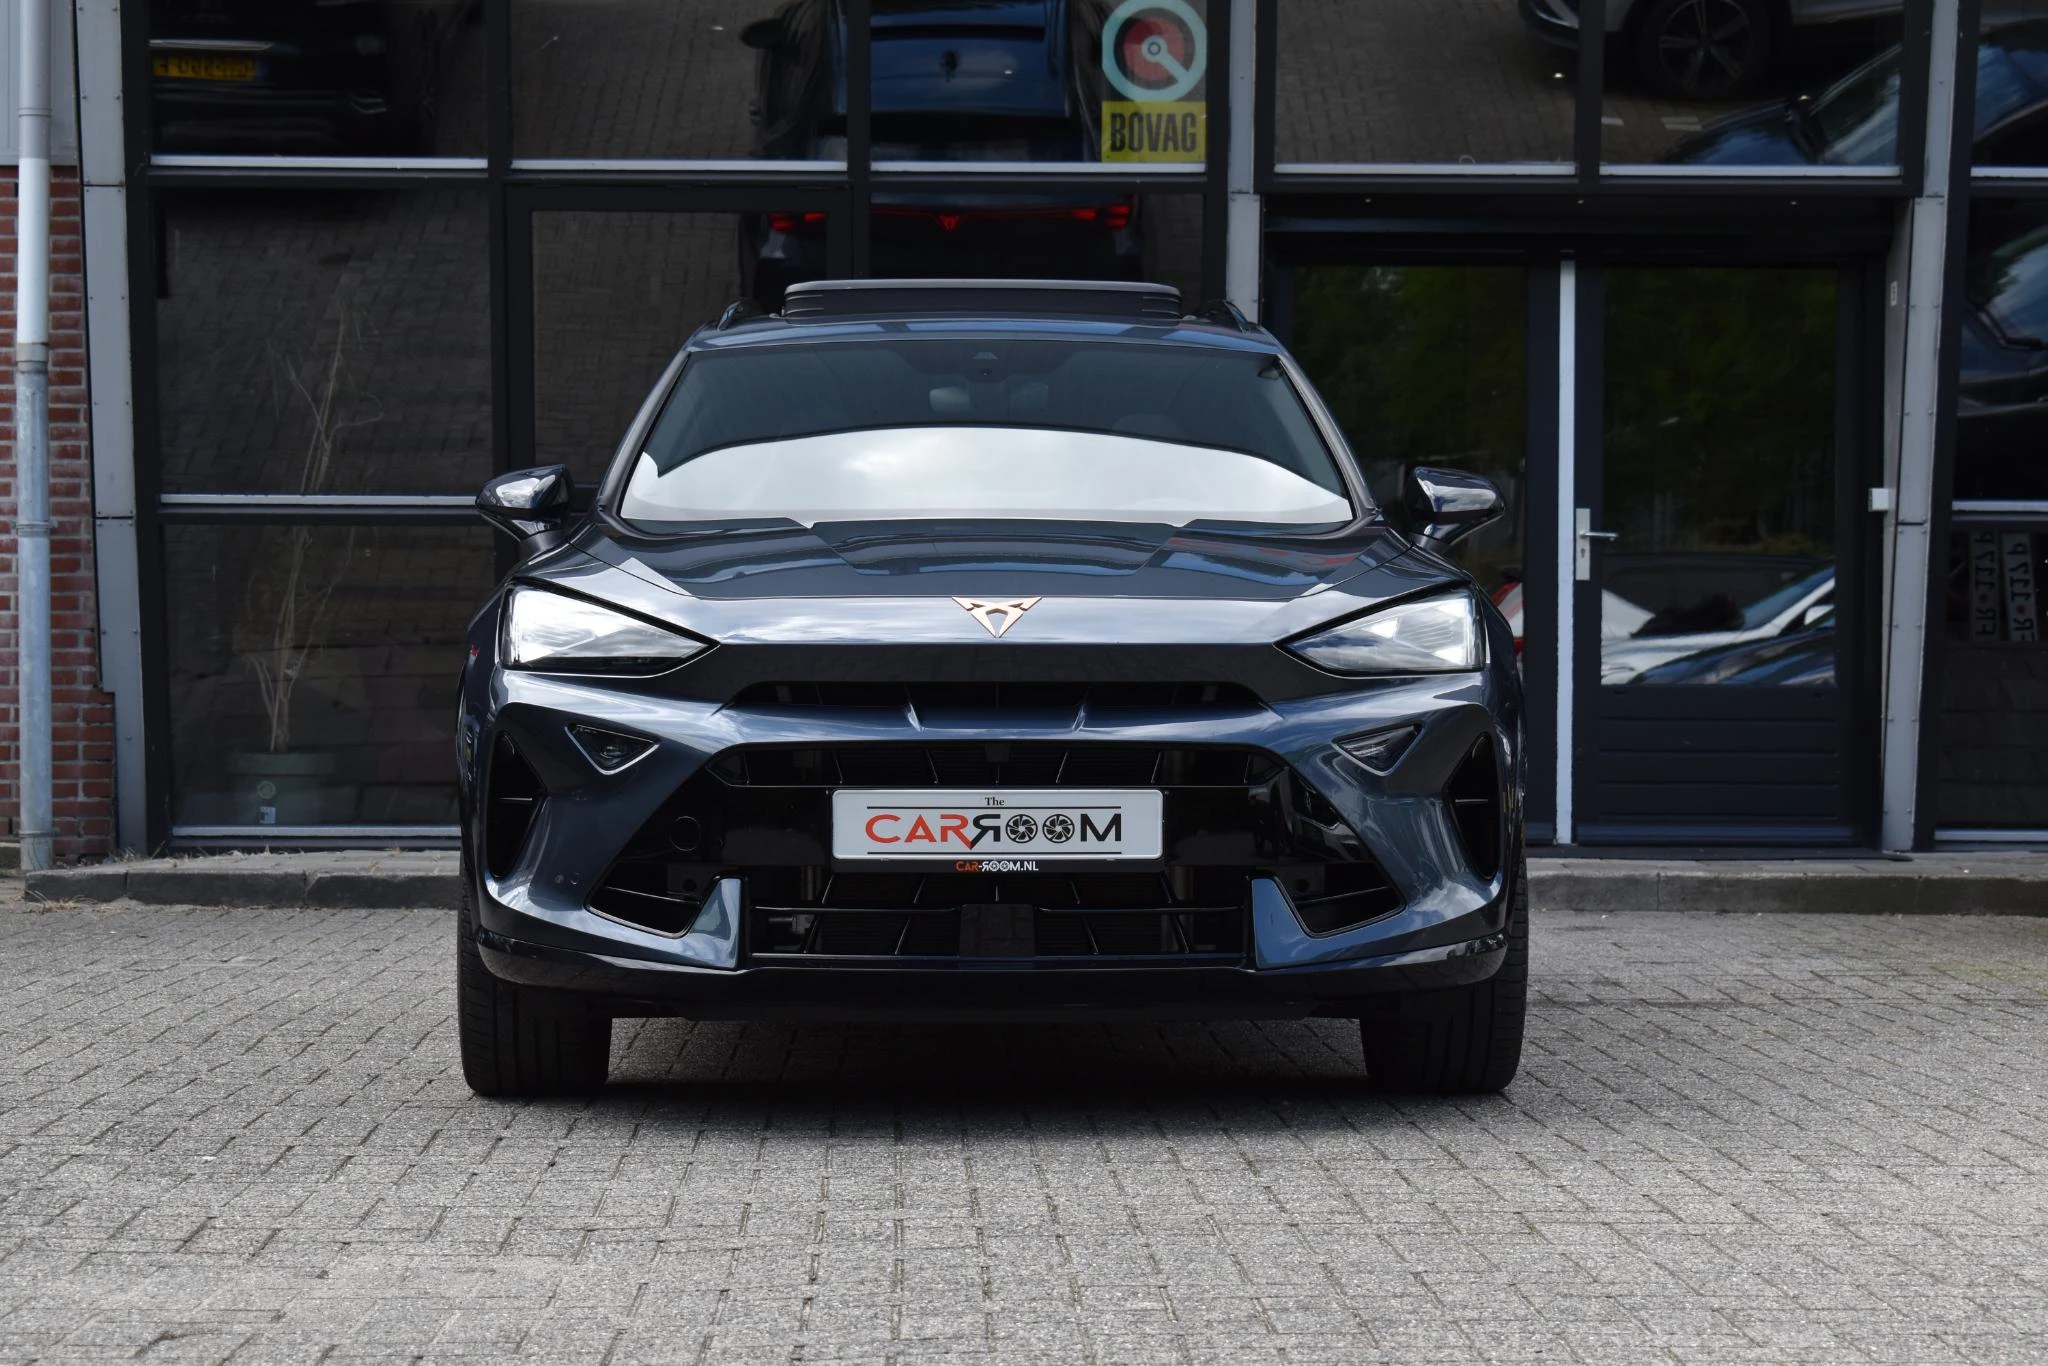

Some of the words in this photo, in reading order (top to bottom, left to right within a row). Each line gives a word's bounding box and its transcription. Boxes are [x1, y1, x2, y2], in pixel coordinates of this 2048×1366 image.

[1110, 112, 1197, 152] BOVAG
[984, 796, 1005, 806] The
[956, 861, 1039, 872] CAR-ROOM.NL
